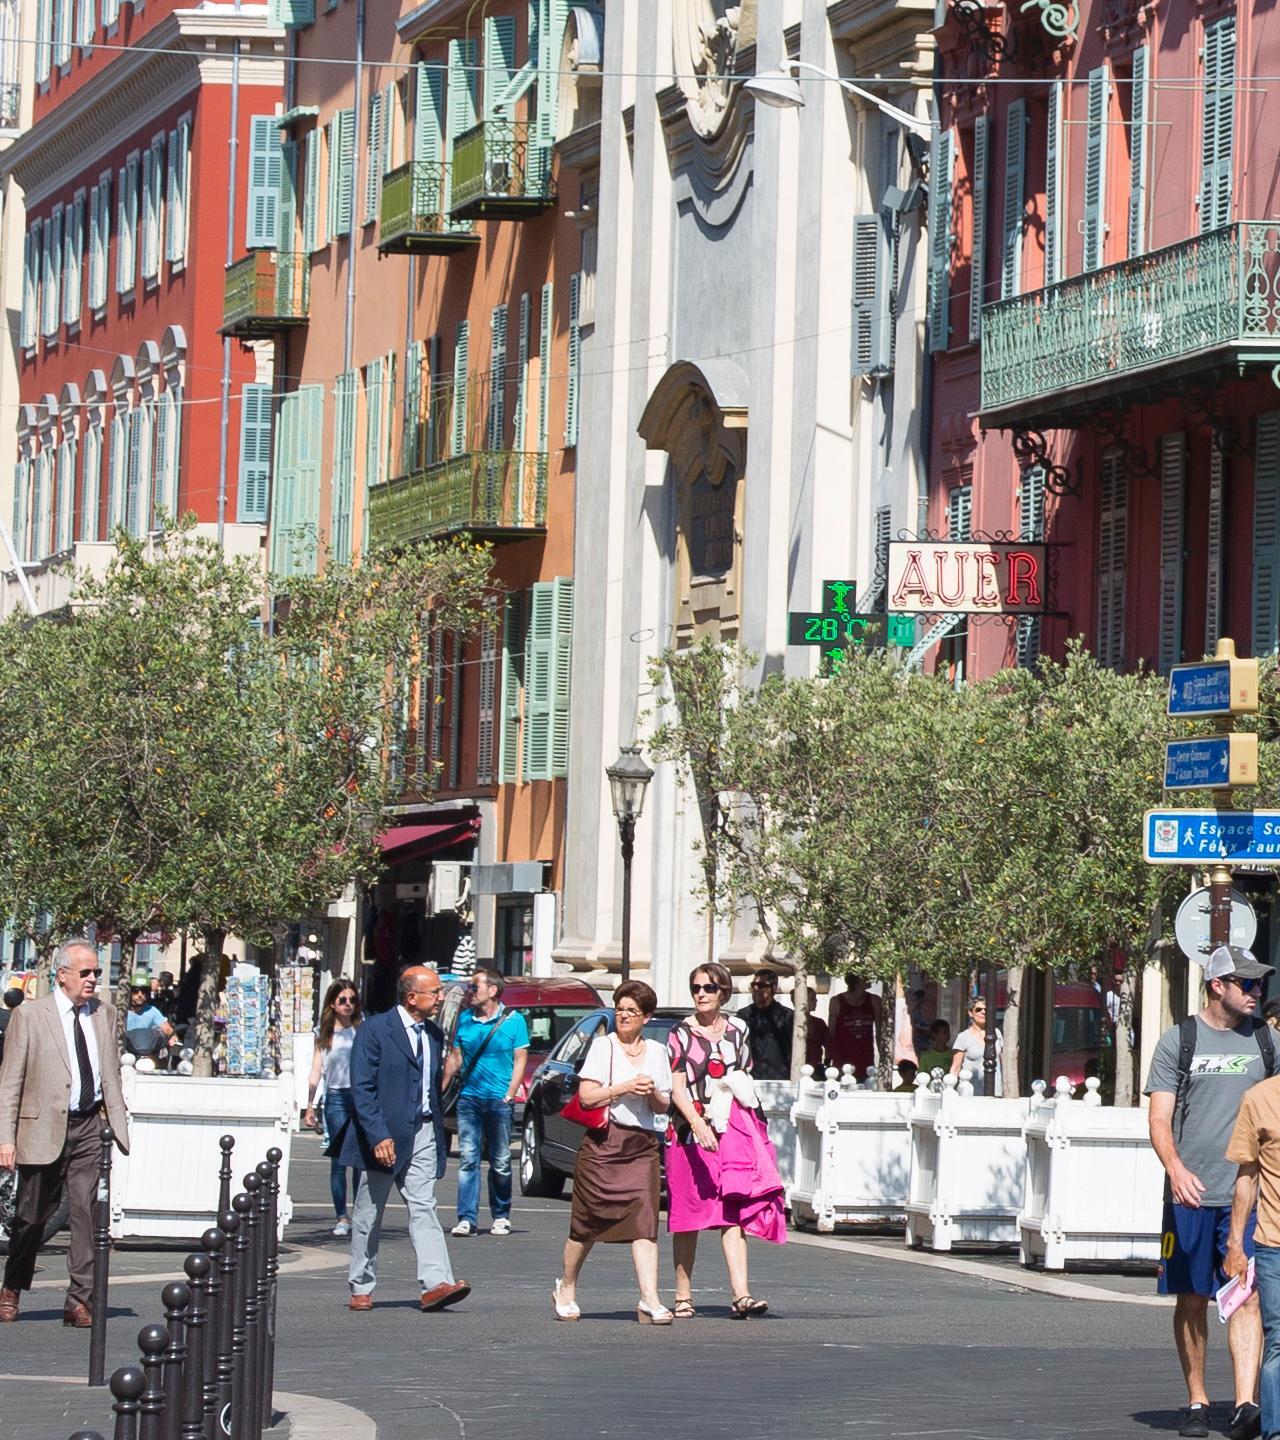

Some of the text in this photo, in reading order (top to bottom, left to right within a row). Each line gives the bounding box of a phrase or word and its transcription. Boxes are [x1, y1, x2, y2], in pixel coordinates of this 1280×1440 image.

[892, 550, 1041, 607] AUER
[1199, 821, 1254, 839] Espace
[1199, 838, 1238, 853] Félix
